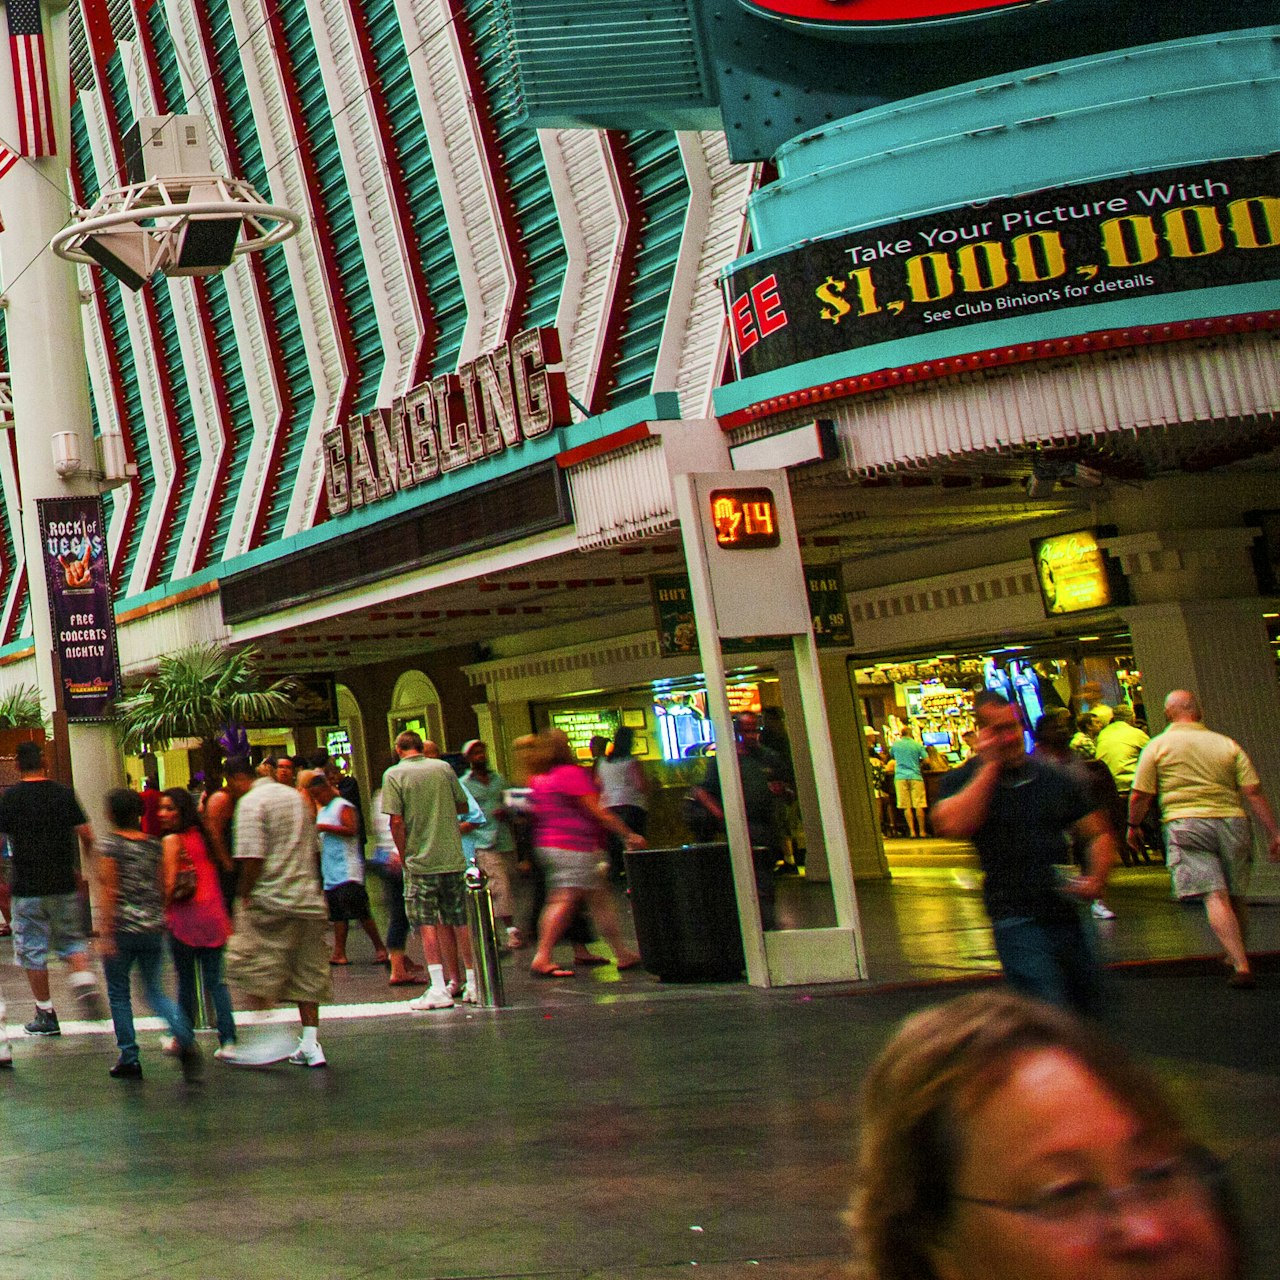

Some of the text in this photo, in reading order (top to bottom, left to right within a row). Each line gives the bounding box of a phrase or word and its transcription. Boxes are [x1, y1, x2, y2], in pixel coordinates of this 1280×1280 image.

[844, 177, 1231, 266] Take Your Picture With
[814, 195, 1280, 326] $1,000,000
[922, 272, 1155, 324] See Club Binion's for details
[321, 326, 560, 517] GAMBLING
[48, 520, 97, 537] ROCK of
[739, 501, 775, 535] 14
[60, 628, 107, 643] CONCERTS
[69, 613, 95, 626] FREE
[65, 645, 105, 659] NIGHTLY
